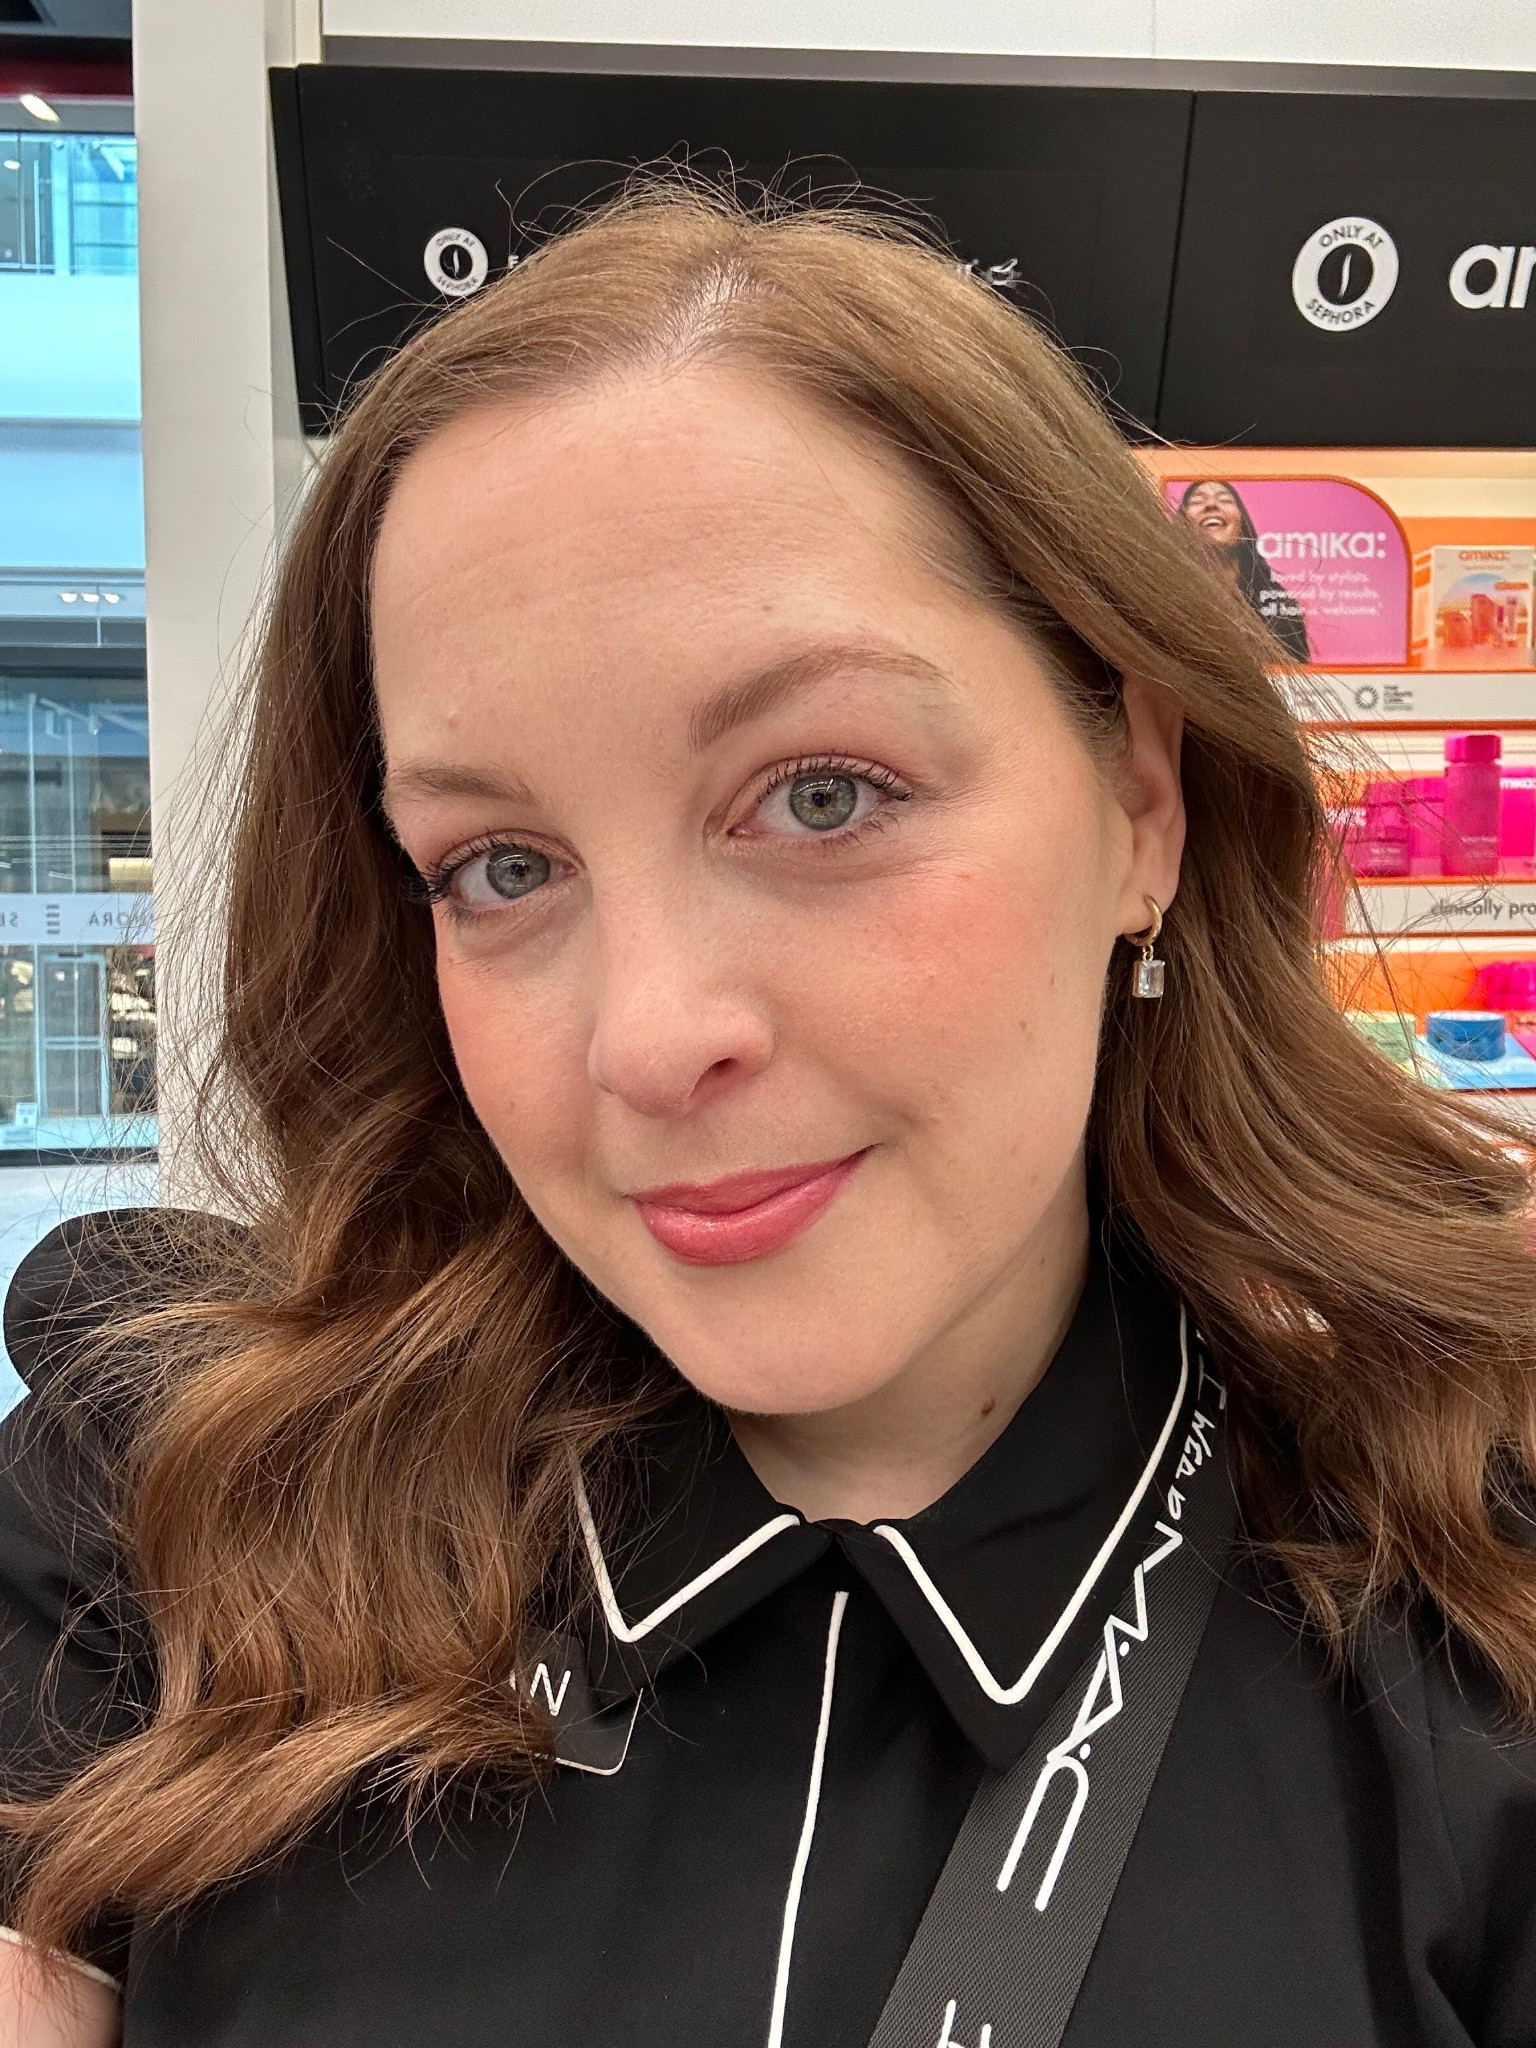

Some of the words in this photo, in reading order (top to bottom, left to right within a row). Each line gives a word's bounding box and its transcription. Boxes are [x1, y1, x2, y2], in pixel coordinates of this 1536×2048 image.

[435, 232, 462, 247] ONLY
[462, 237, 476, 248] AT
[1319, 225, 1364, 248] ONLY
[1364, 232, 1384, 249] AT
[437, 275, 478, 292] SEPHORA
[1305, 297, 1376, 325] SEPHORA
